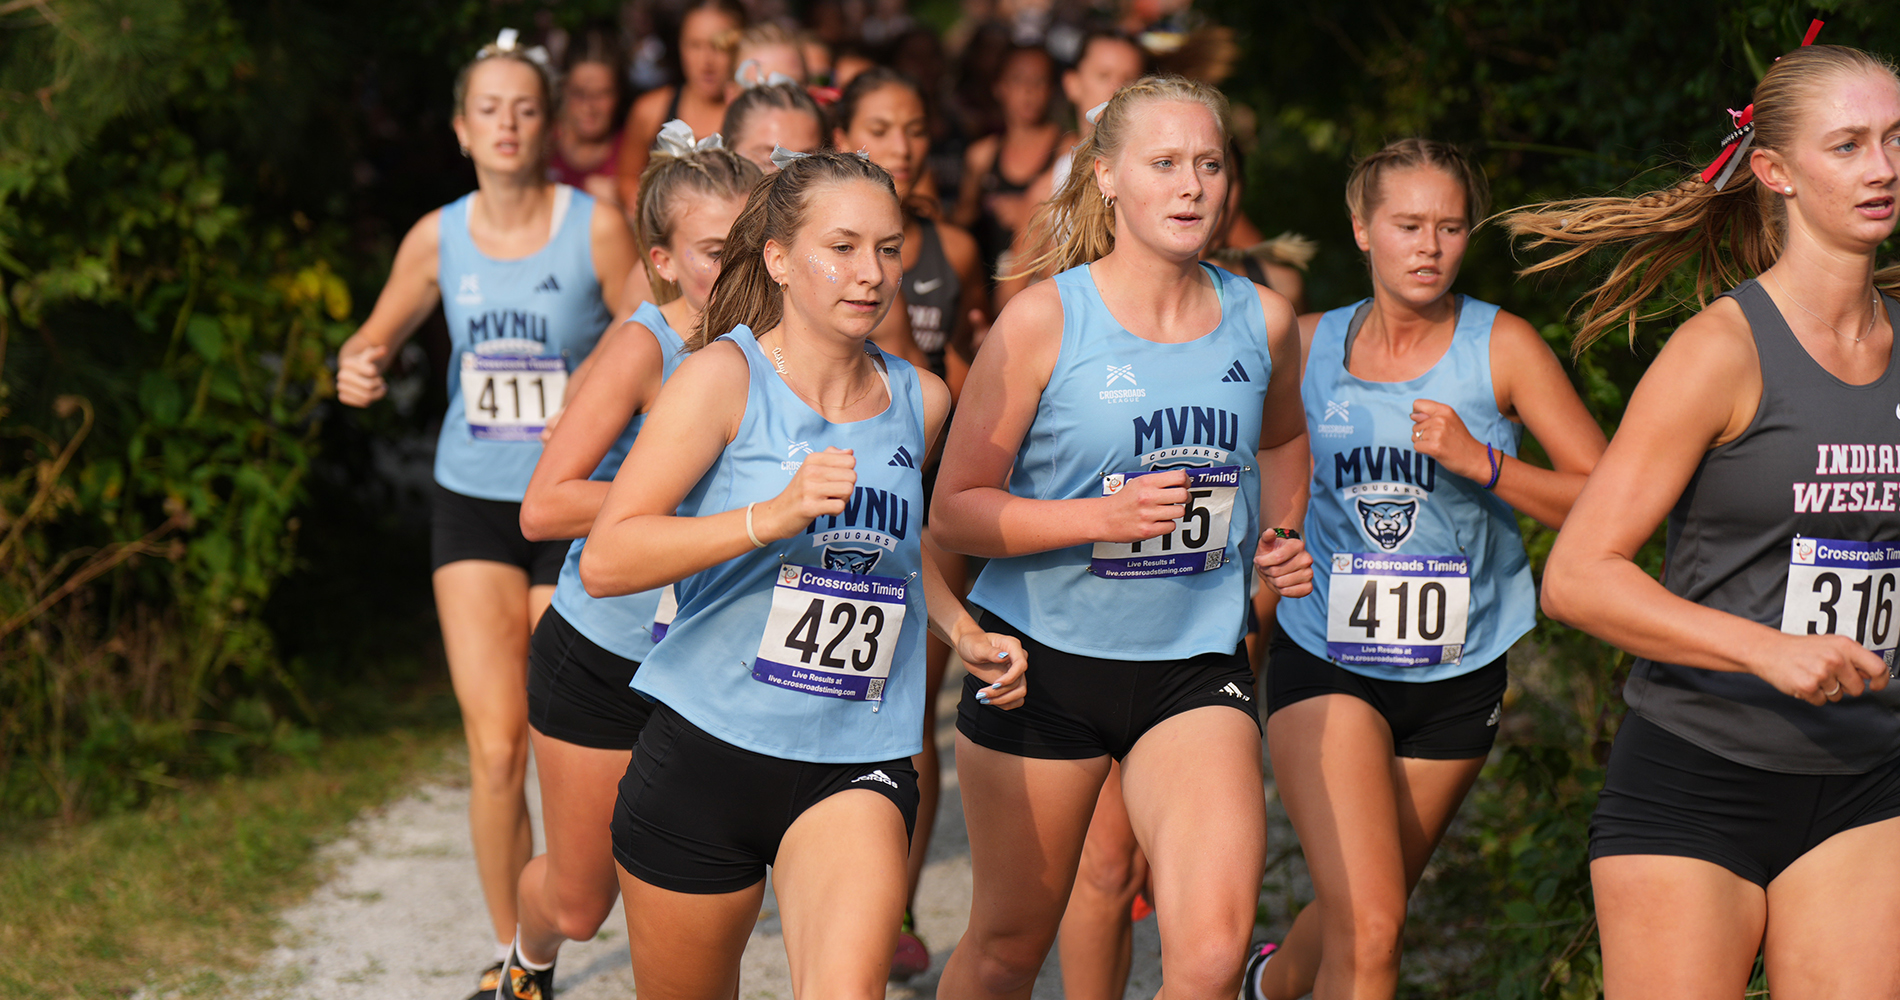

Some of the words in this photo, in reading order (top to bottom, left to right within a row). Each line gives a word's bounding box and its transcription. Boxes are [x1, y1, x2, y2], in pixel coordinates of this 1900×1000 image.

[468, 311, 547, 344] MVNU
[478, 376, 546, 418] 411
[1099, 389, 1146, 400] CROSSROADS
[1132, 406, 1238, 457] MVNU
[1149, 449, 1220, 461] COUGARS
[1334, 446, 1436, 493] MVNU
[1198, 472, 1238, 484] Timing
[1352, 484, 1420, 495] COUGARS
[1793, 481, 1900, 513] WESLE
[822, 532, 890, 546] COUGARS
[1817, 545, 1884, 562] Crossroads
[1105, 565, 1193, 577] live.crossroadstiming.com
[1146, 559, 1168, 567] Results
[1353, 558, 1424, 571] Crossroads
[1427, 560, 1467, 574] Timing
[802, 573, 870, 593] Crossroads
[872, 582, 905, 600] Timing
[1349, 580, 1446, 641] 410
[1807, 572, 1896, 646] 316
[784, 598, 884, 672] 423
[1377, 647, 1403, 655] Results
[1342, 654, 1429, 665] live.crossroadstiming.com
[768, 674, 856, 697] live.crossroadstiming.com
[792, 670, 808, 680] Live
[808, 673, 834, 685] Results
